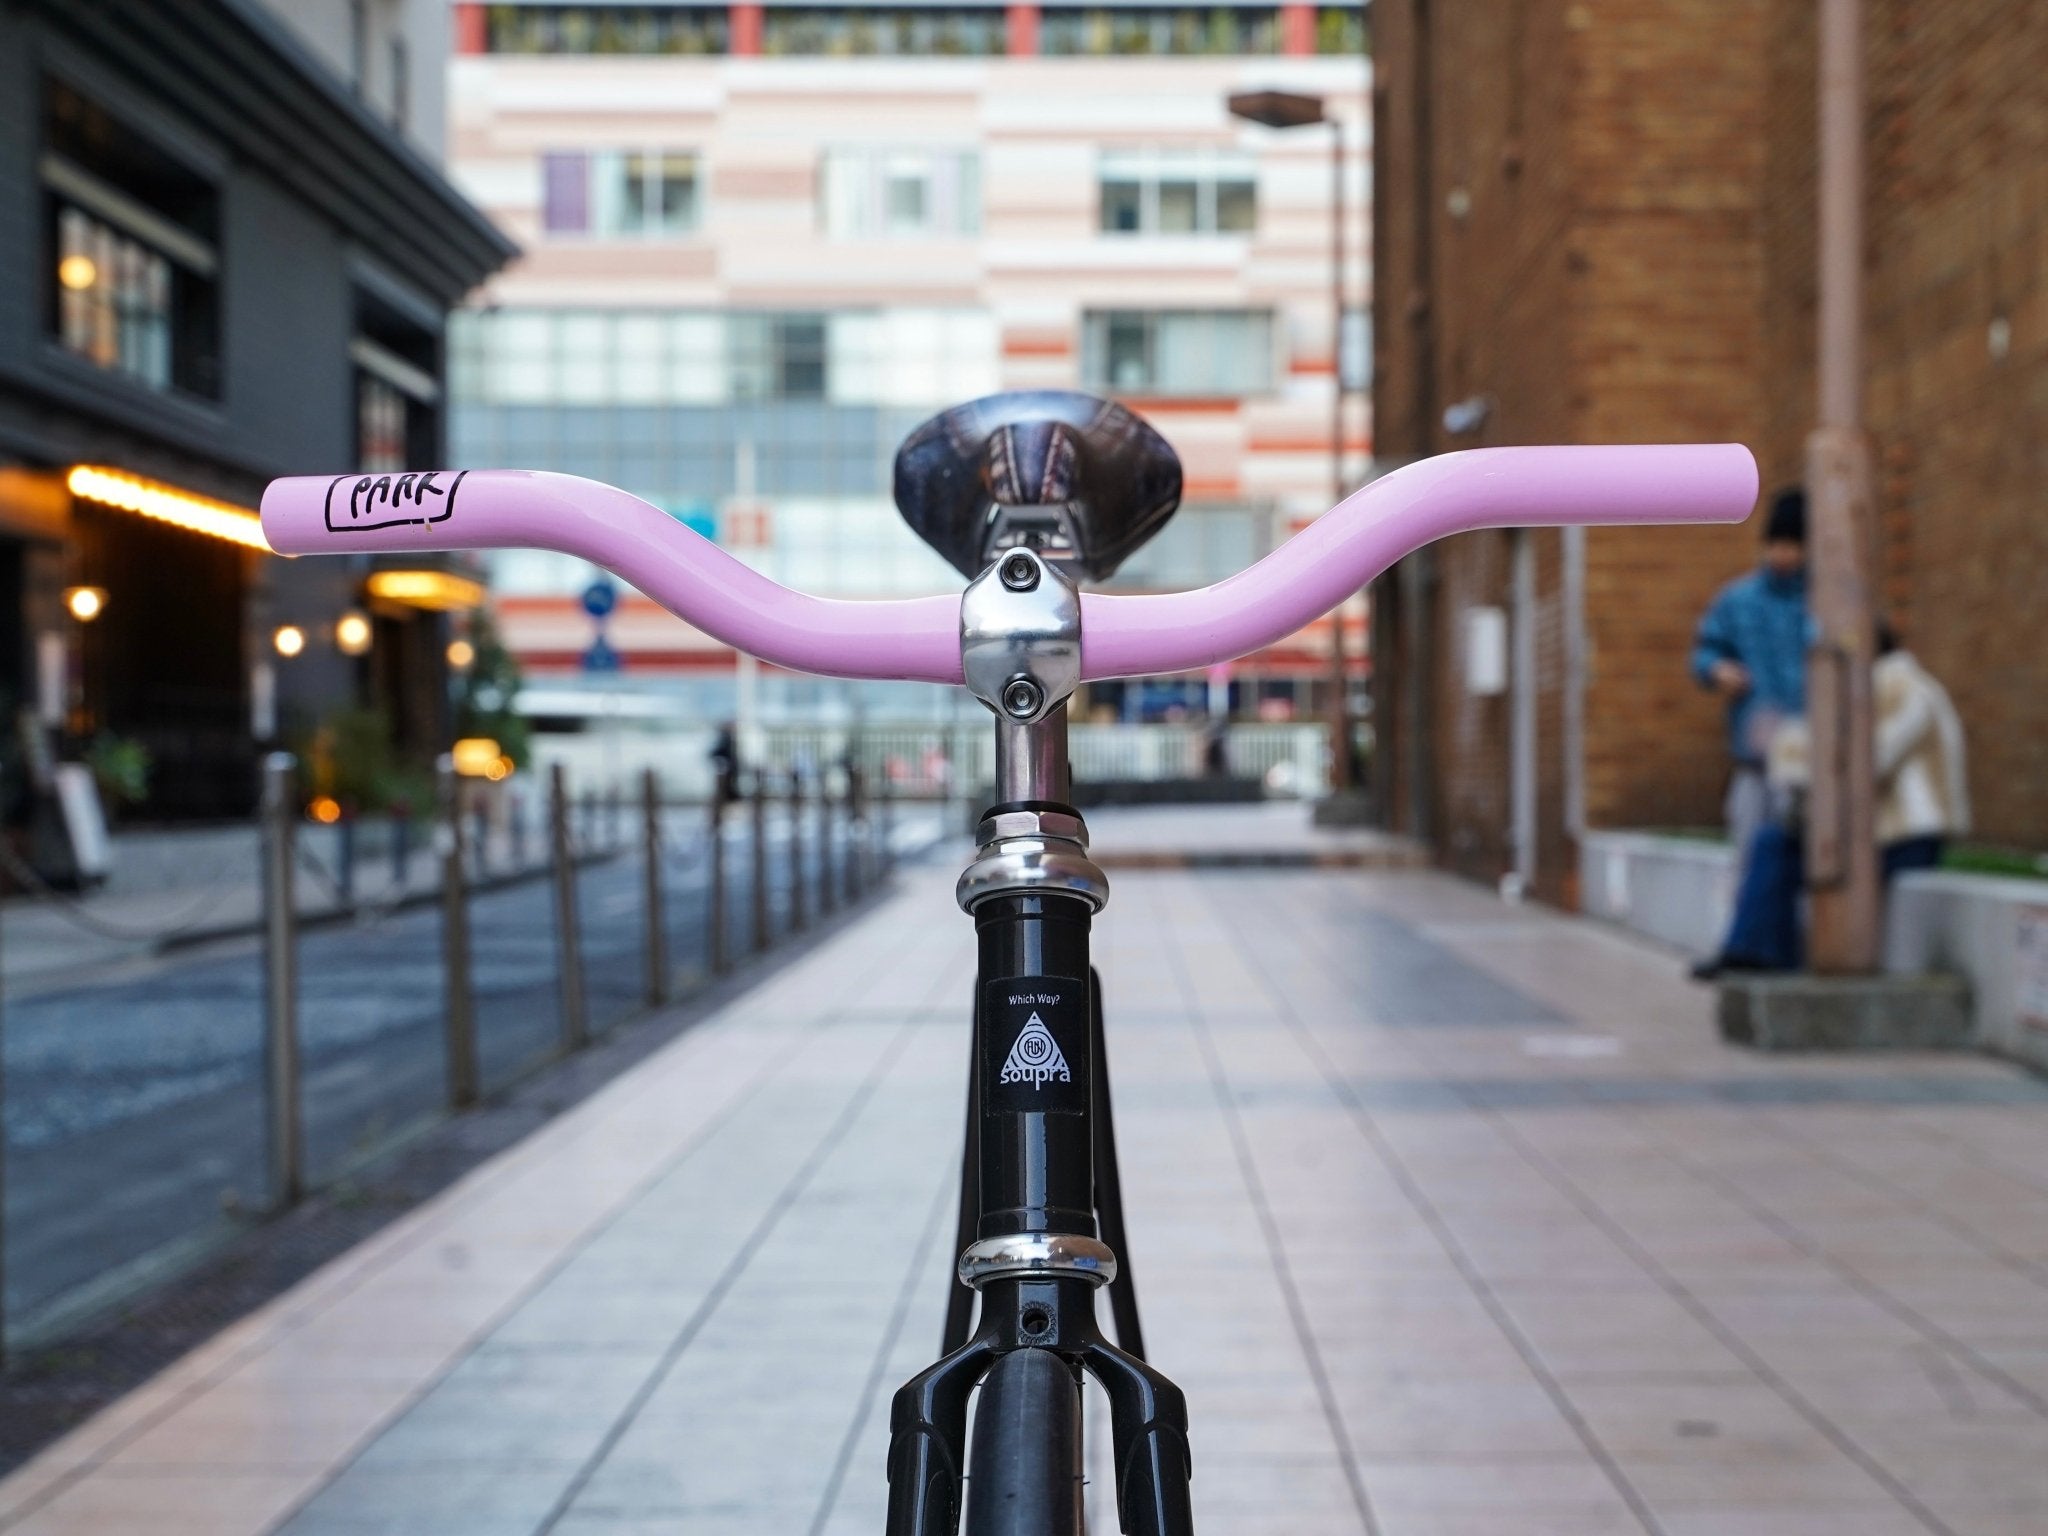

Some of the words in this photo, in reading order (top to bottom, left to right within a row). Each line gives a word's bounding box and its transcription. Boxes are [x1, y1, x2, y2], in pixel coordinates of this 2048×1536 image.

[351, 472, 444, 519] PARK
[1009, 994, 1035, 1005] Which
[1037, 993, 1060, 1006] Way?
[1000, 1068, 1071, 1091] soupra
